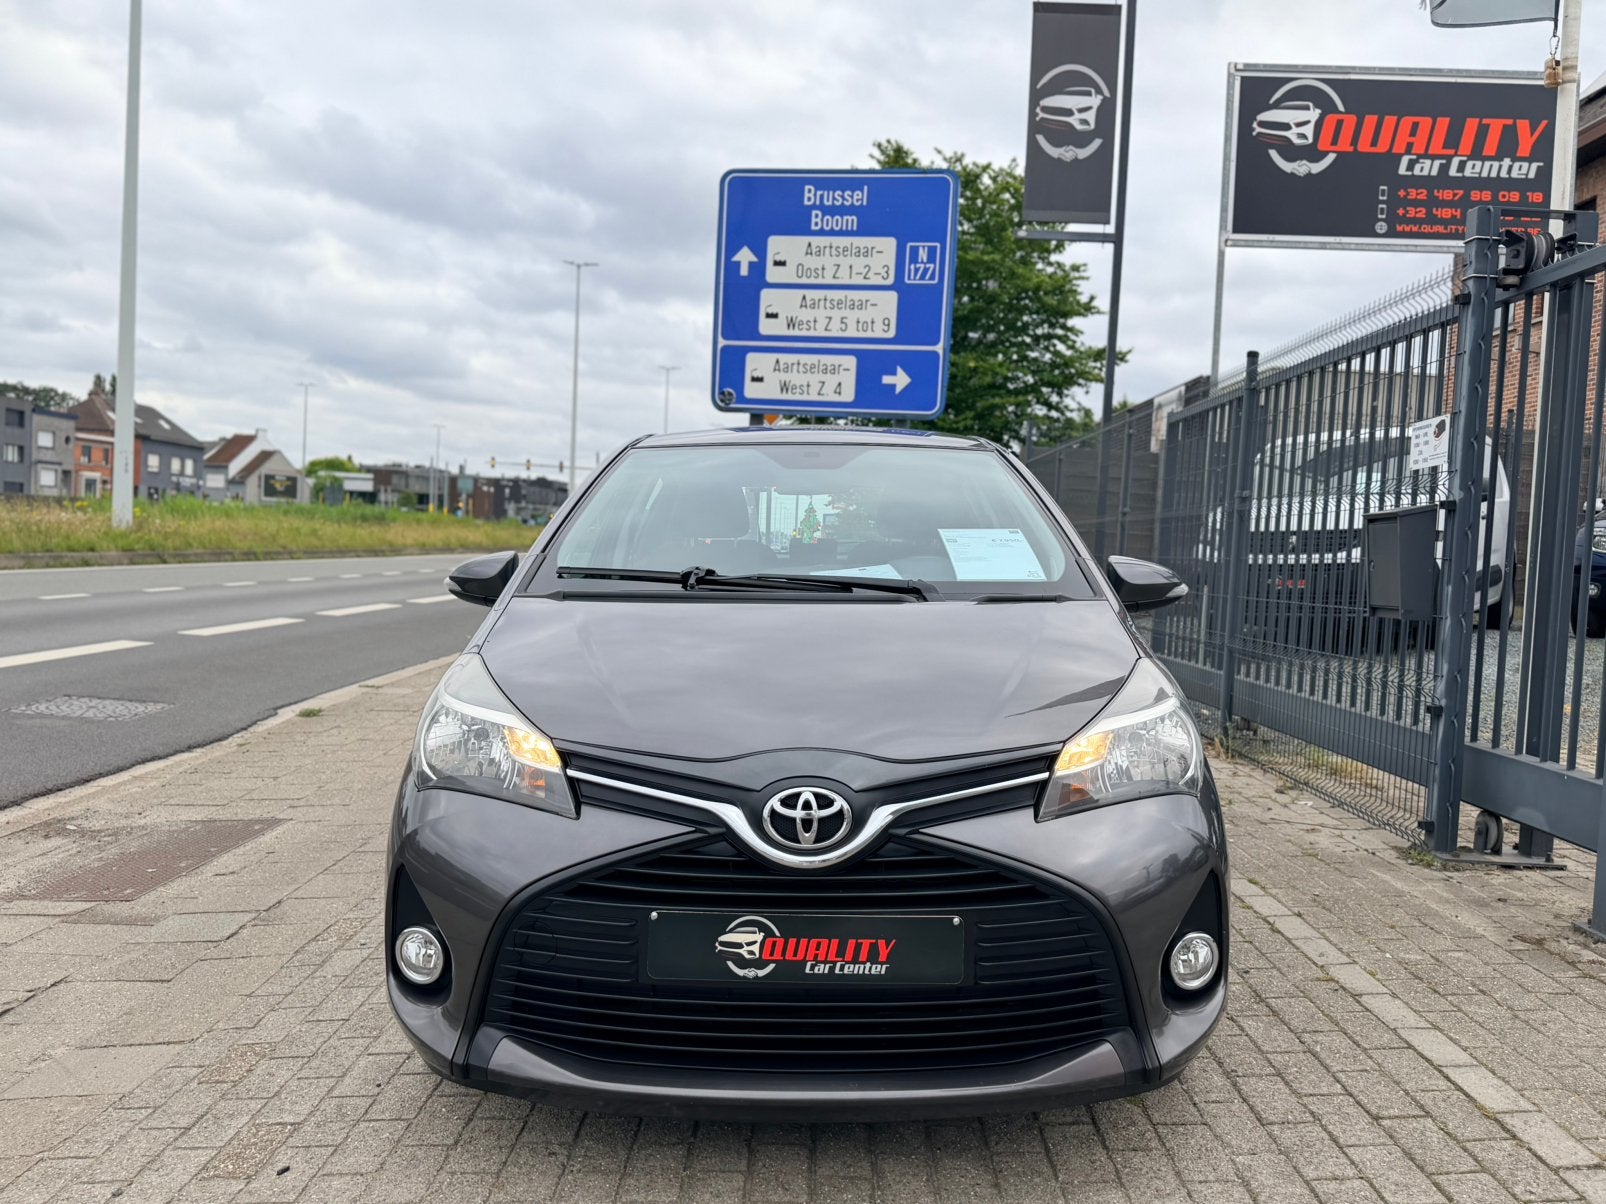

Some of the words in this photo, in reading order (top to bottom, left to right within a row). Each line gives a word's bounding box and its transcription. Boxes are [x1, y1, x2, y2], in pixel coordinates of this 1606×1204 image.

[1317, 113, 1549, 157] QUALITY
[1398, 155, 1447, 176] Car
[1448, 156, 1544, 179] Center
[803, 185, 868, 206] Brussel
[1398, 188, 1428, 200] +32
[1433, 189, 1465, 201] 487
[1526, 192, 1544, 203] 18
[810, 210, 858, 231] Boom
[1396, 207, 1427, 219] +32
[1432, 208, 1462, 219] 484
[804, 241, 884, 258] Aartselaar-
[918, 246, 928, 262] N
[795, 263, 827, 280] Oost
[909, 264, 935, 280] 177
[799, 294, 878, 311] Aartselaar-
[786, 315, 818, 332] West
[856, 317, 876, 333] tot
[882, 317, 891, 333] 9
[772, 358, 851, 375] Aartselaar-
[779, 379, 811, 396] West
[762, 937, 896, 962] QUALITY
[805, 961, 833, 974] Car
[835, 961, 890, 975] Center
